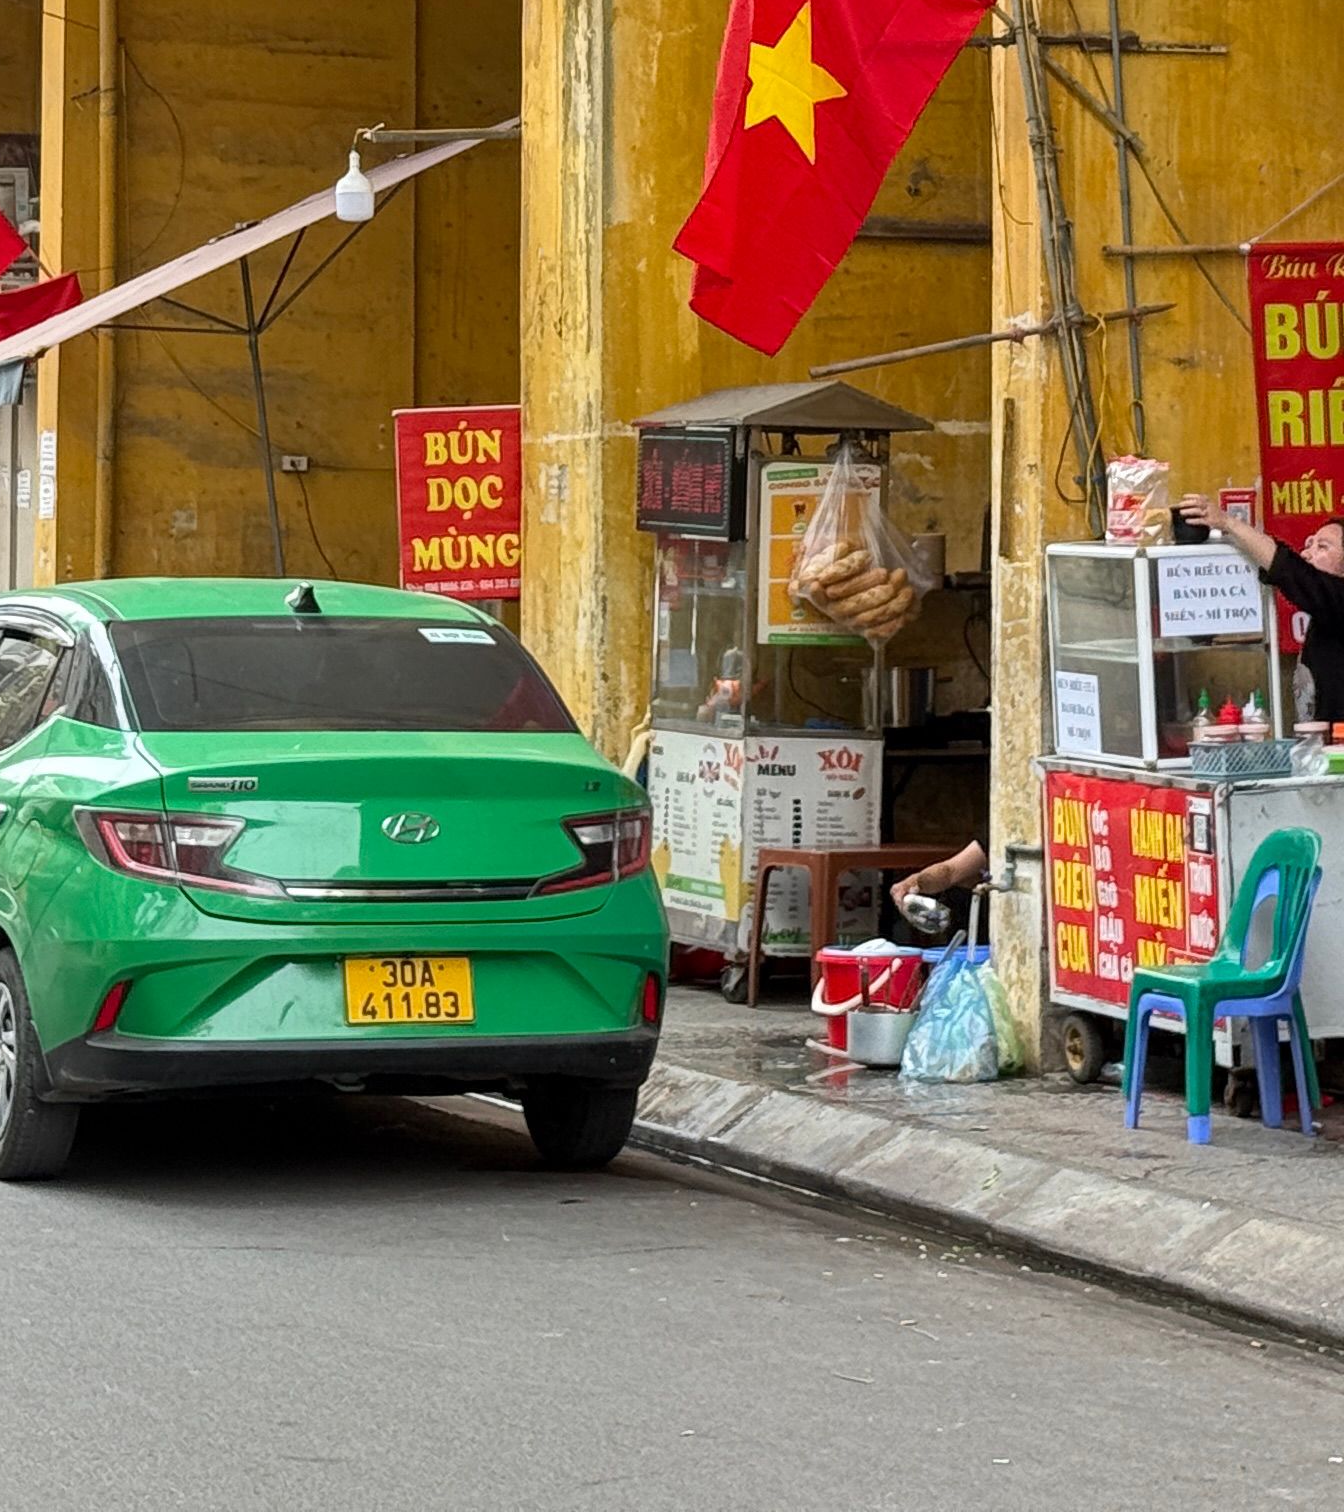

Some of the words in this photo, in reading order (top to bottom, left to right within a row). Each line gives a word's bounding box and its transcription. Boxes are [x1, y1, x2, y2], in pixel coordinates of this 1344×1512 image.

[1262, 254, 1318, 278] Bún
[424, 420, 503, 466] BÚN
[426, 475, 503, 520] DỌC
[1270, 468, 1334, 515] MIẾN
[411, 526, 521, 572] MÙNG
[1225, 564, 1252, 575] CUA
[757, 763, 796, 776] MENU
[818, 746, 864, 772] XÔI
[1053, 789, 1088, 848] BÚN
[1130, 798, 1165, 860] BÁNH
[1054, 852, 1094, 912] RIÊU
[1135, 862, 1184, 930] MIẾN
[1057, 921, 1092, 975] CUA
[381, 960, 436, 988] 30A
[362, 991, 460, 1019] 411.83
